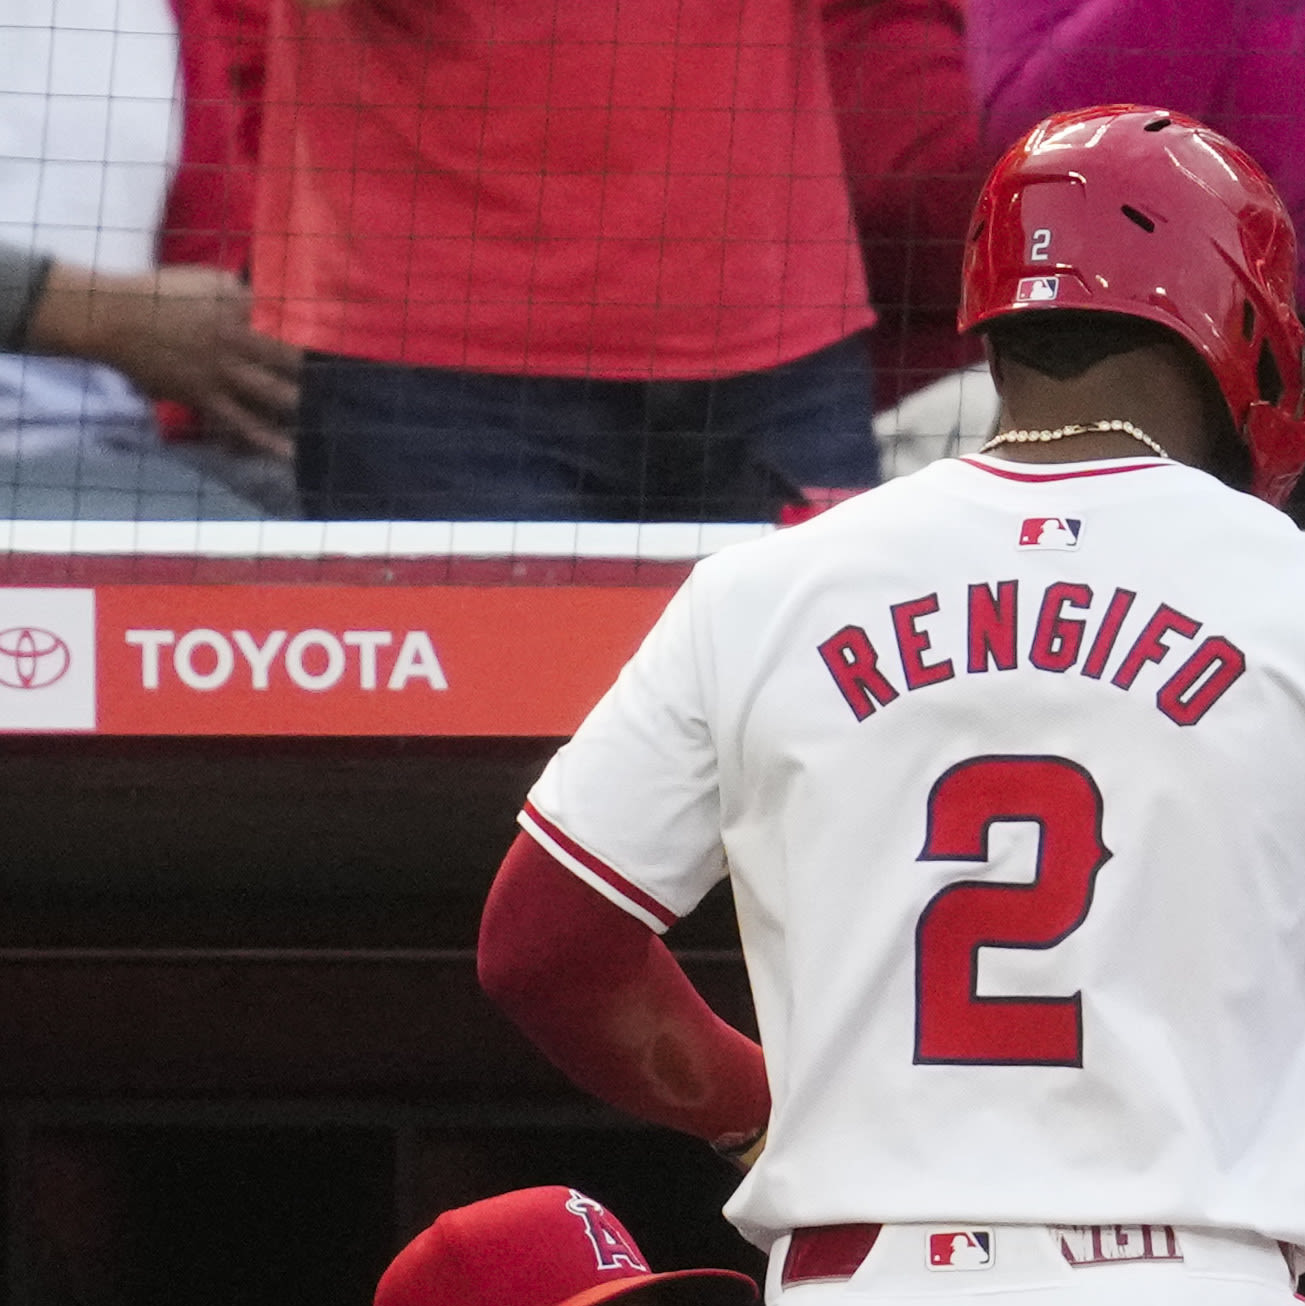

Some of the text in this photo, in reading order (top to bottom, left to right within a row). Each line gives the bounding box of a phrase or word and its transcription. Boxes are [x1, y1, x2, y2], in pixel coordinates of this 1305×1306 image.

[1030, 227, 1052, 261] 2
[124, 627, 449, 692] TOYOTA
[816, 578, 1247, 728] RENGIFO
[912, 753, 1115, 1069] 2
[565, 1187, 648, 1273] A
